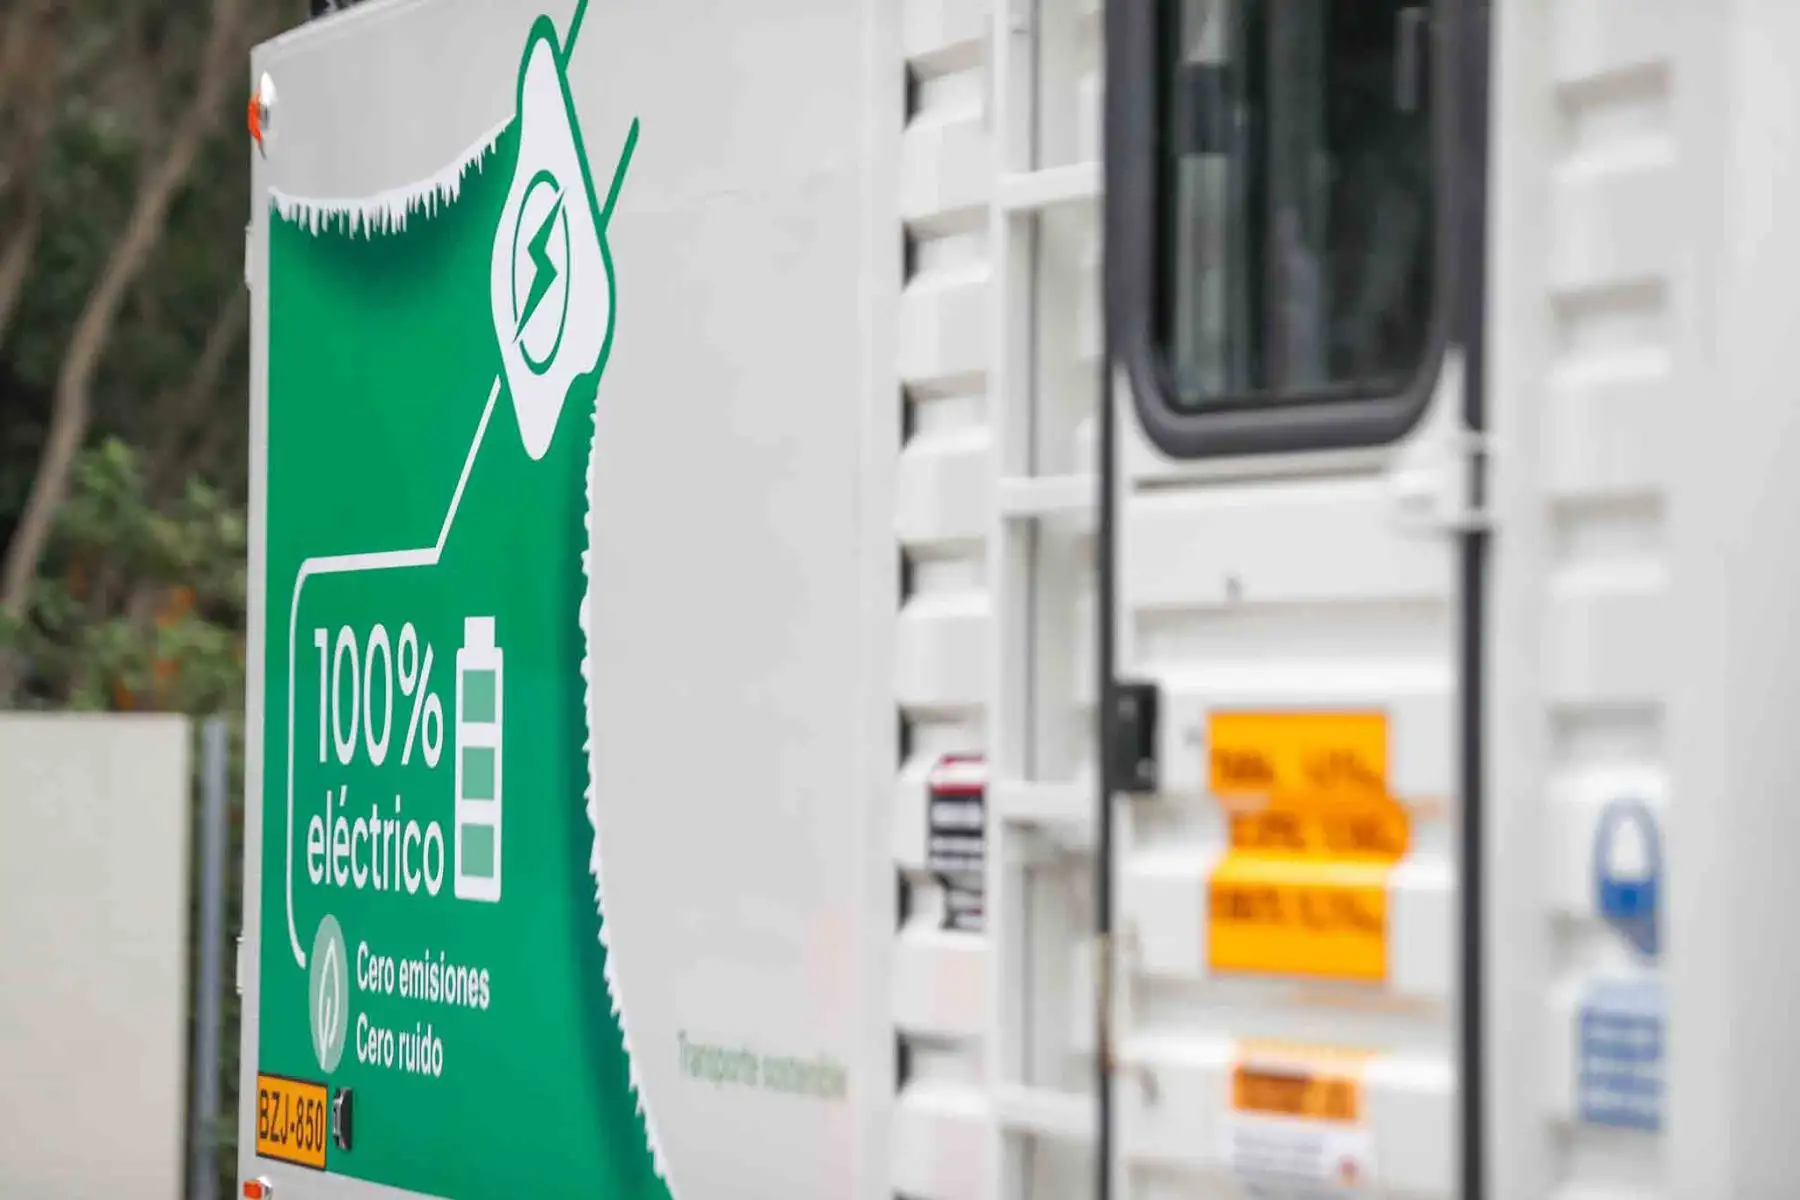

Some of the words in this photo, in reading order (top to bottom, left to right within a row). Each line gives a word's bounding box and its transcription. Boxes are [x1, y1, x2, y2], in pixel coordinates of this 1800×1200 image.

[314, 622, 444, 768] 100%
[307, 785, 445, 896] eléctrico
[356, 940, 395, 994] Cero
[399, 948, 490, 1010] emisiones
[356, 1011, 395, 1068] Cero
[398, 1021, 443, 1077] ruido
[259, 1088, 324, 1152] BZJ-850
